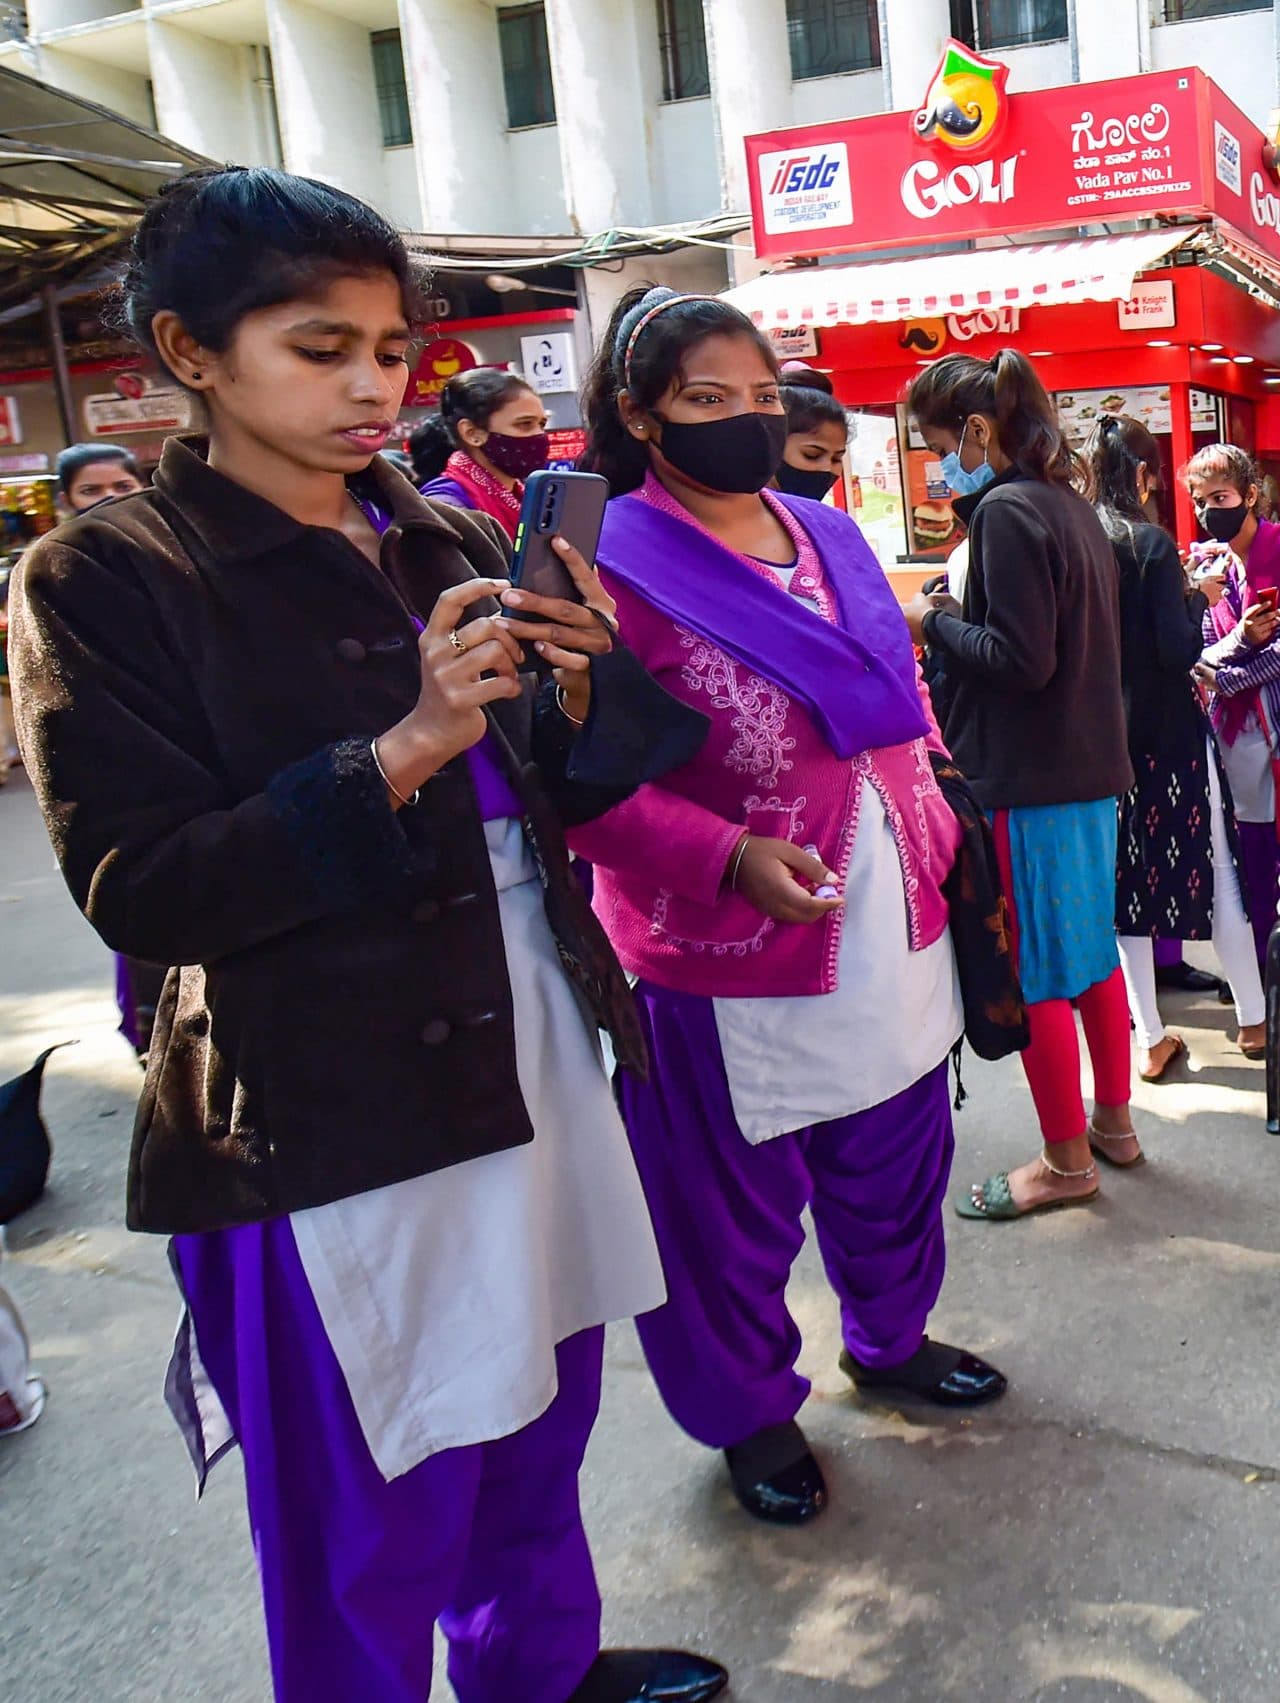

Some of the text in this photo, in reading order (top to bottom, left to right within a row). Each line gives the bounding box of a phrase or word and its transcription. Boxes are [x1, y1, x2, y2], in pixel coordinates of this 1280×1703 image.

[1071, 103, 1170, 152] ಗೋಲಿ
[1075, 173, 1110, 190] Vada
[1113, 170, 1138, 186] Pav
